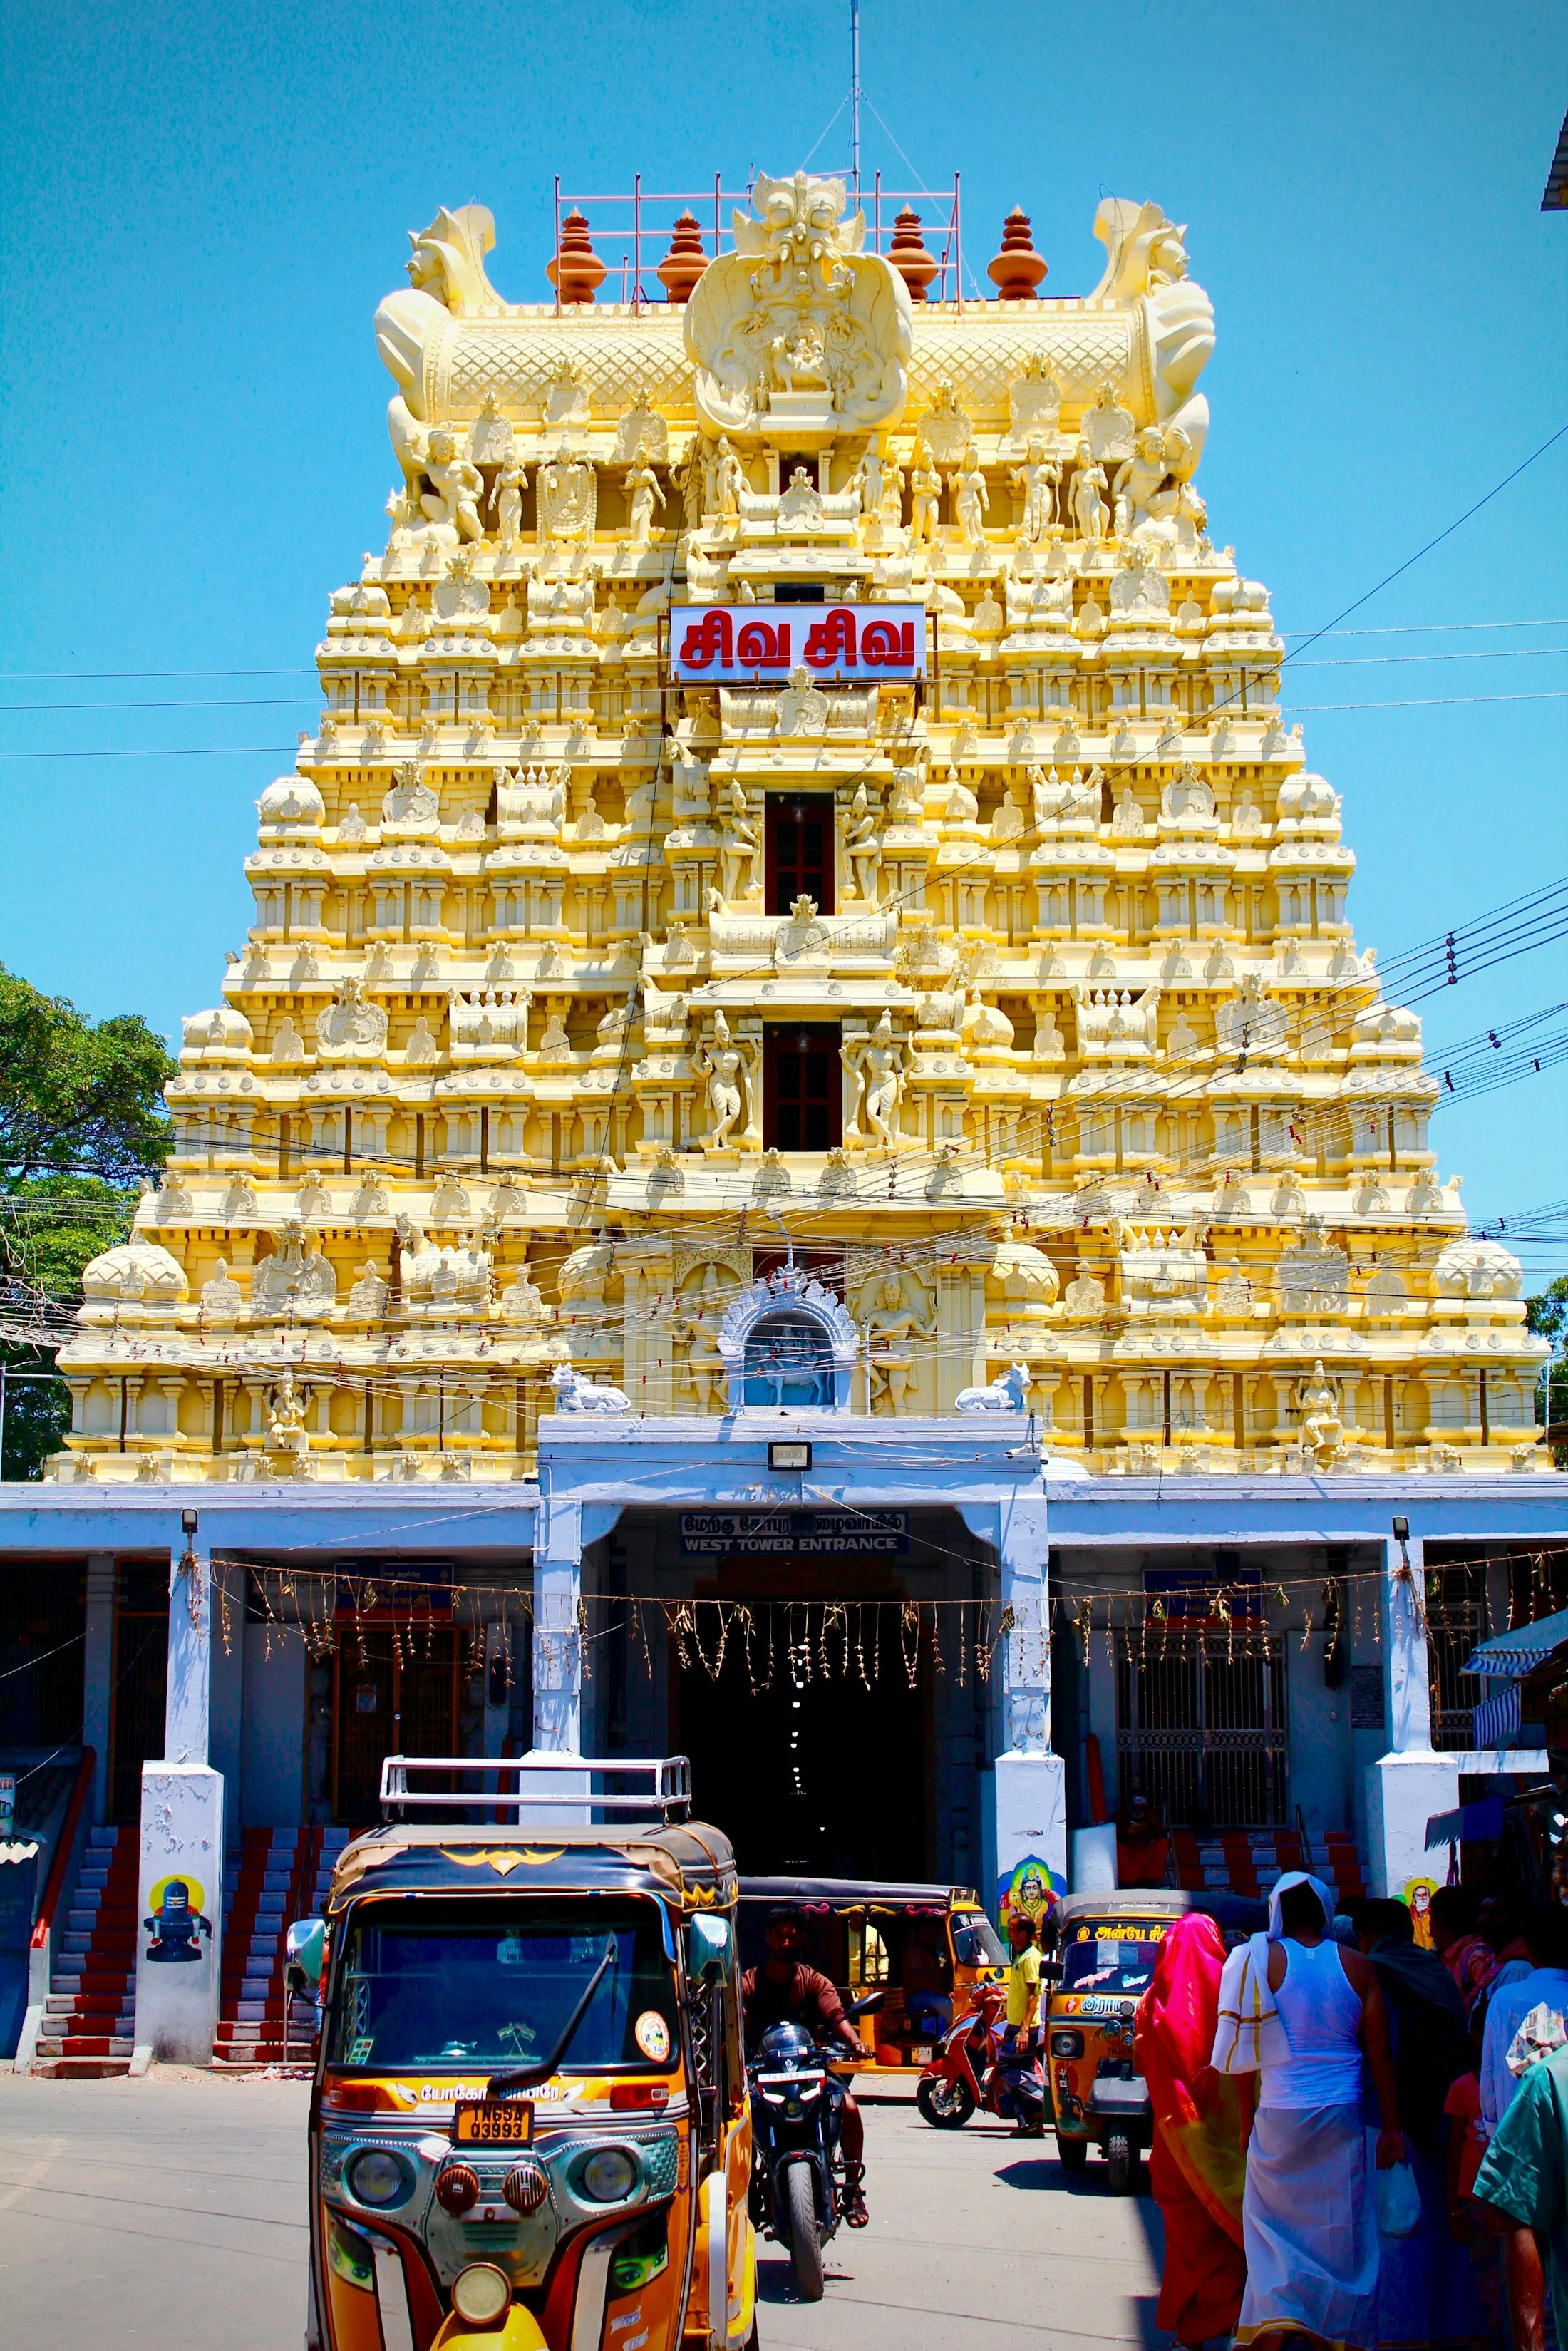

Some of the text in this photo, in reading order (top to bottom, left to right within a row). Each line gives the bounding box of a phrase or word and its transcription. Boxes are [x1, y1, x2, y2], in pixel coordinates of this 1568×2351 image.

[679, 609, 914, 669] சிவ சிவ
[685, 1538, 897, 1552] WEST TOWER ENTRANCE
[1094, 1923, 1146, 1940] அன்பே
[473, 2104, 523, 2121] TN65A
